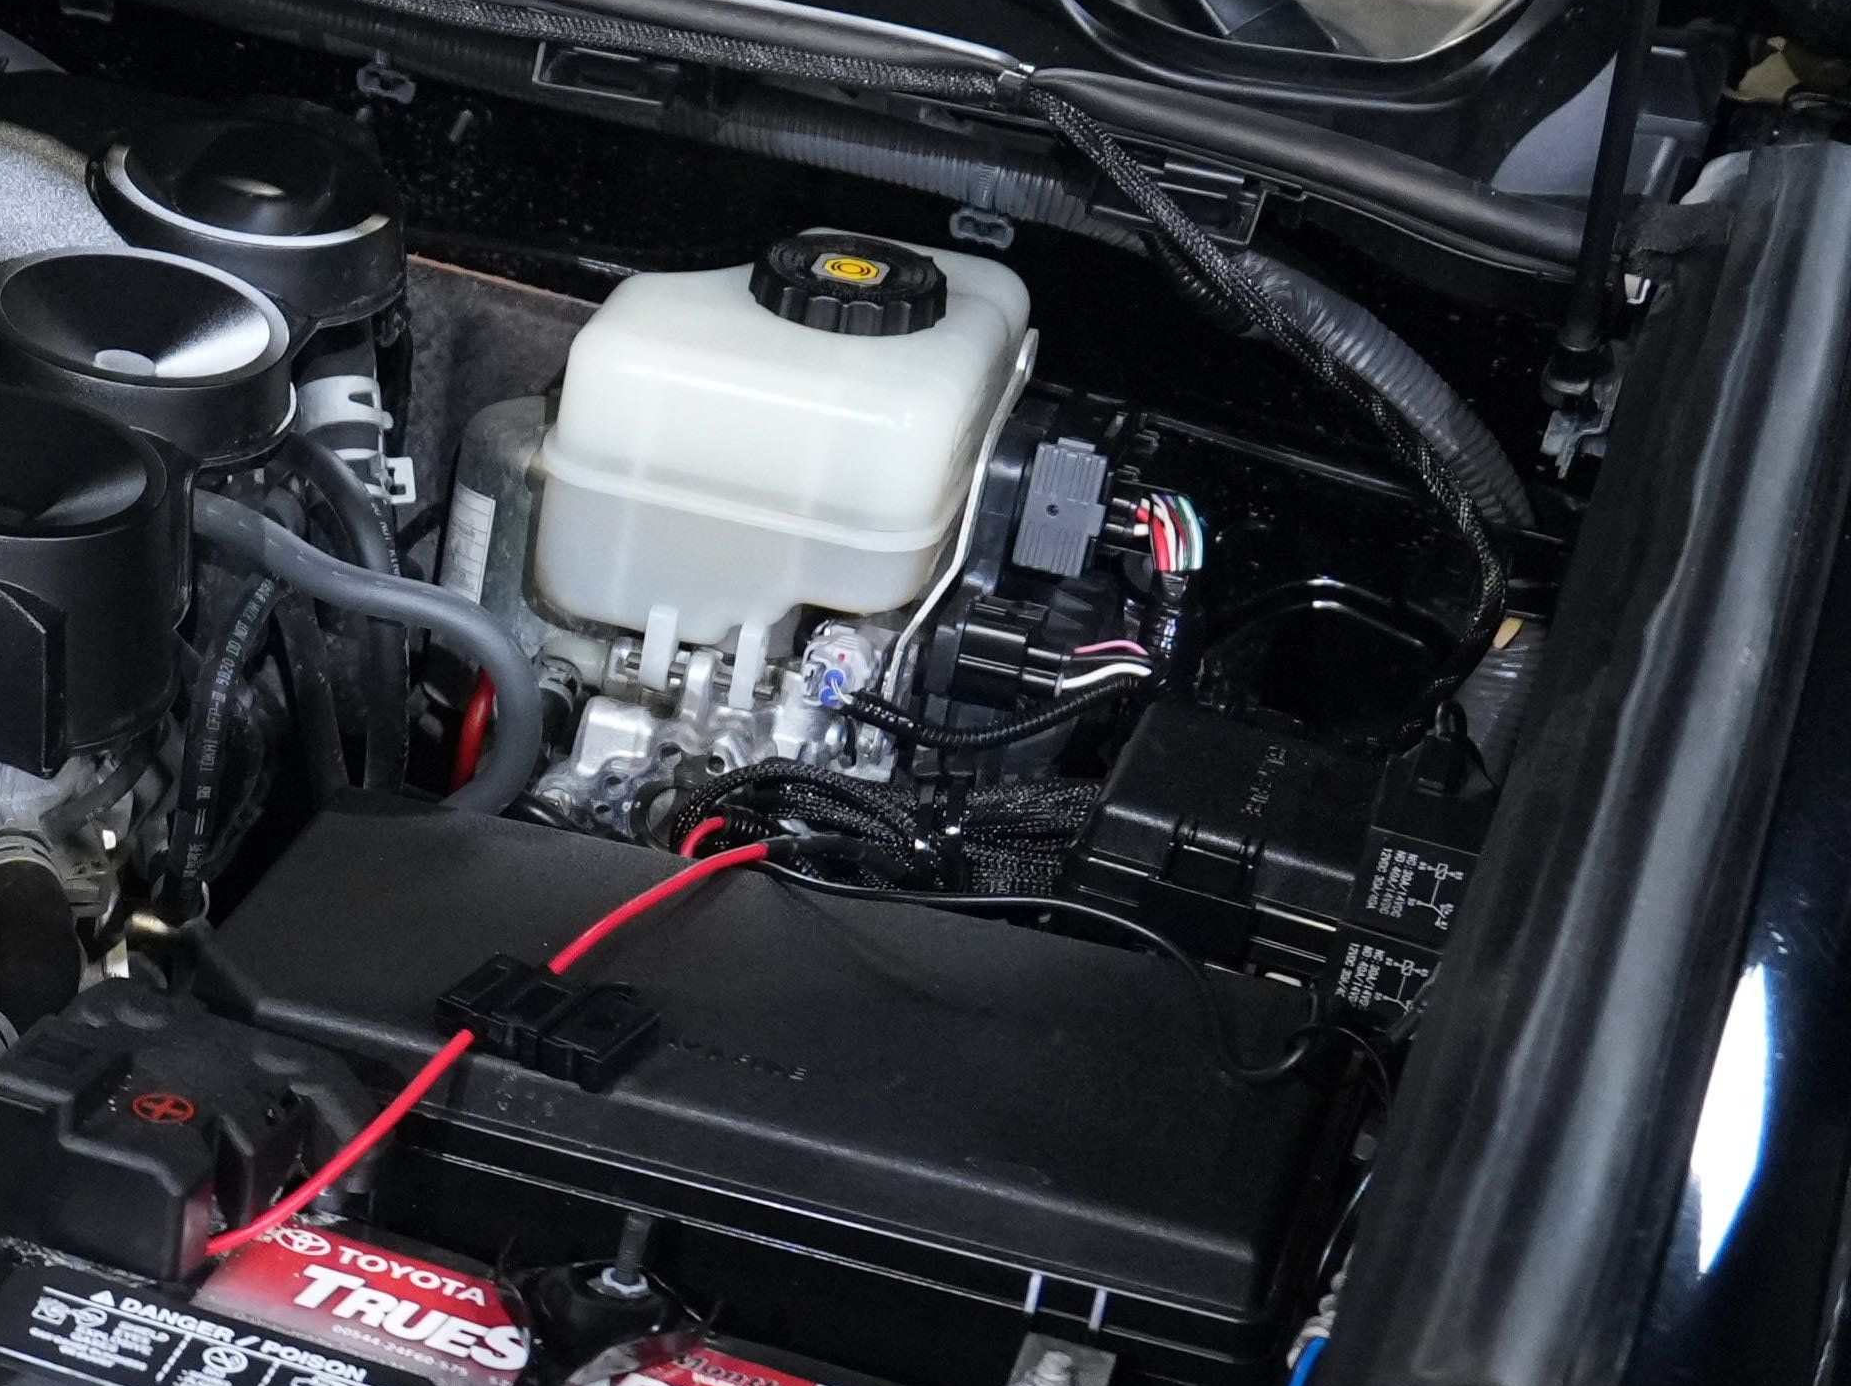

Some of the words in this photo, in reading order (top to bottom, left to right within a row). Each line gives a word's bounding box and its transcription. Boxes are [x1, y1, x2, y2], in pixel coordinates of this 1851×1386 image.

[293, 1263, 531, 1371] TRUES
[339, 1245, 487, 1307] TOYOTA
[119, 1296, 236, 1344] DANGER
[261, 1339, 368, 1384] POISON
